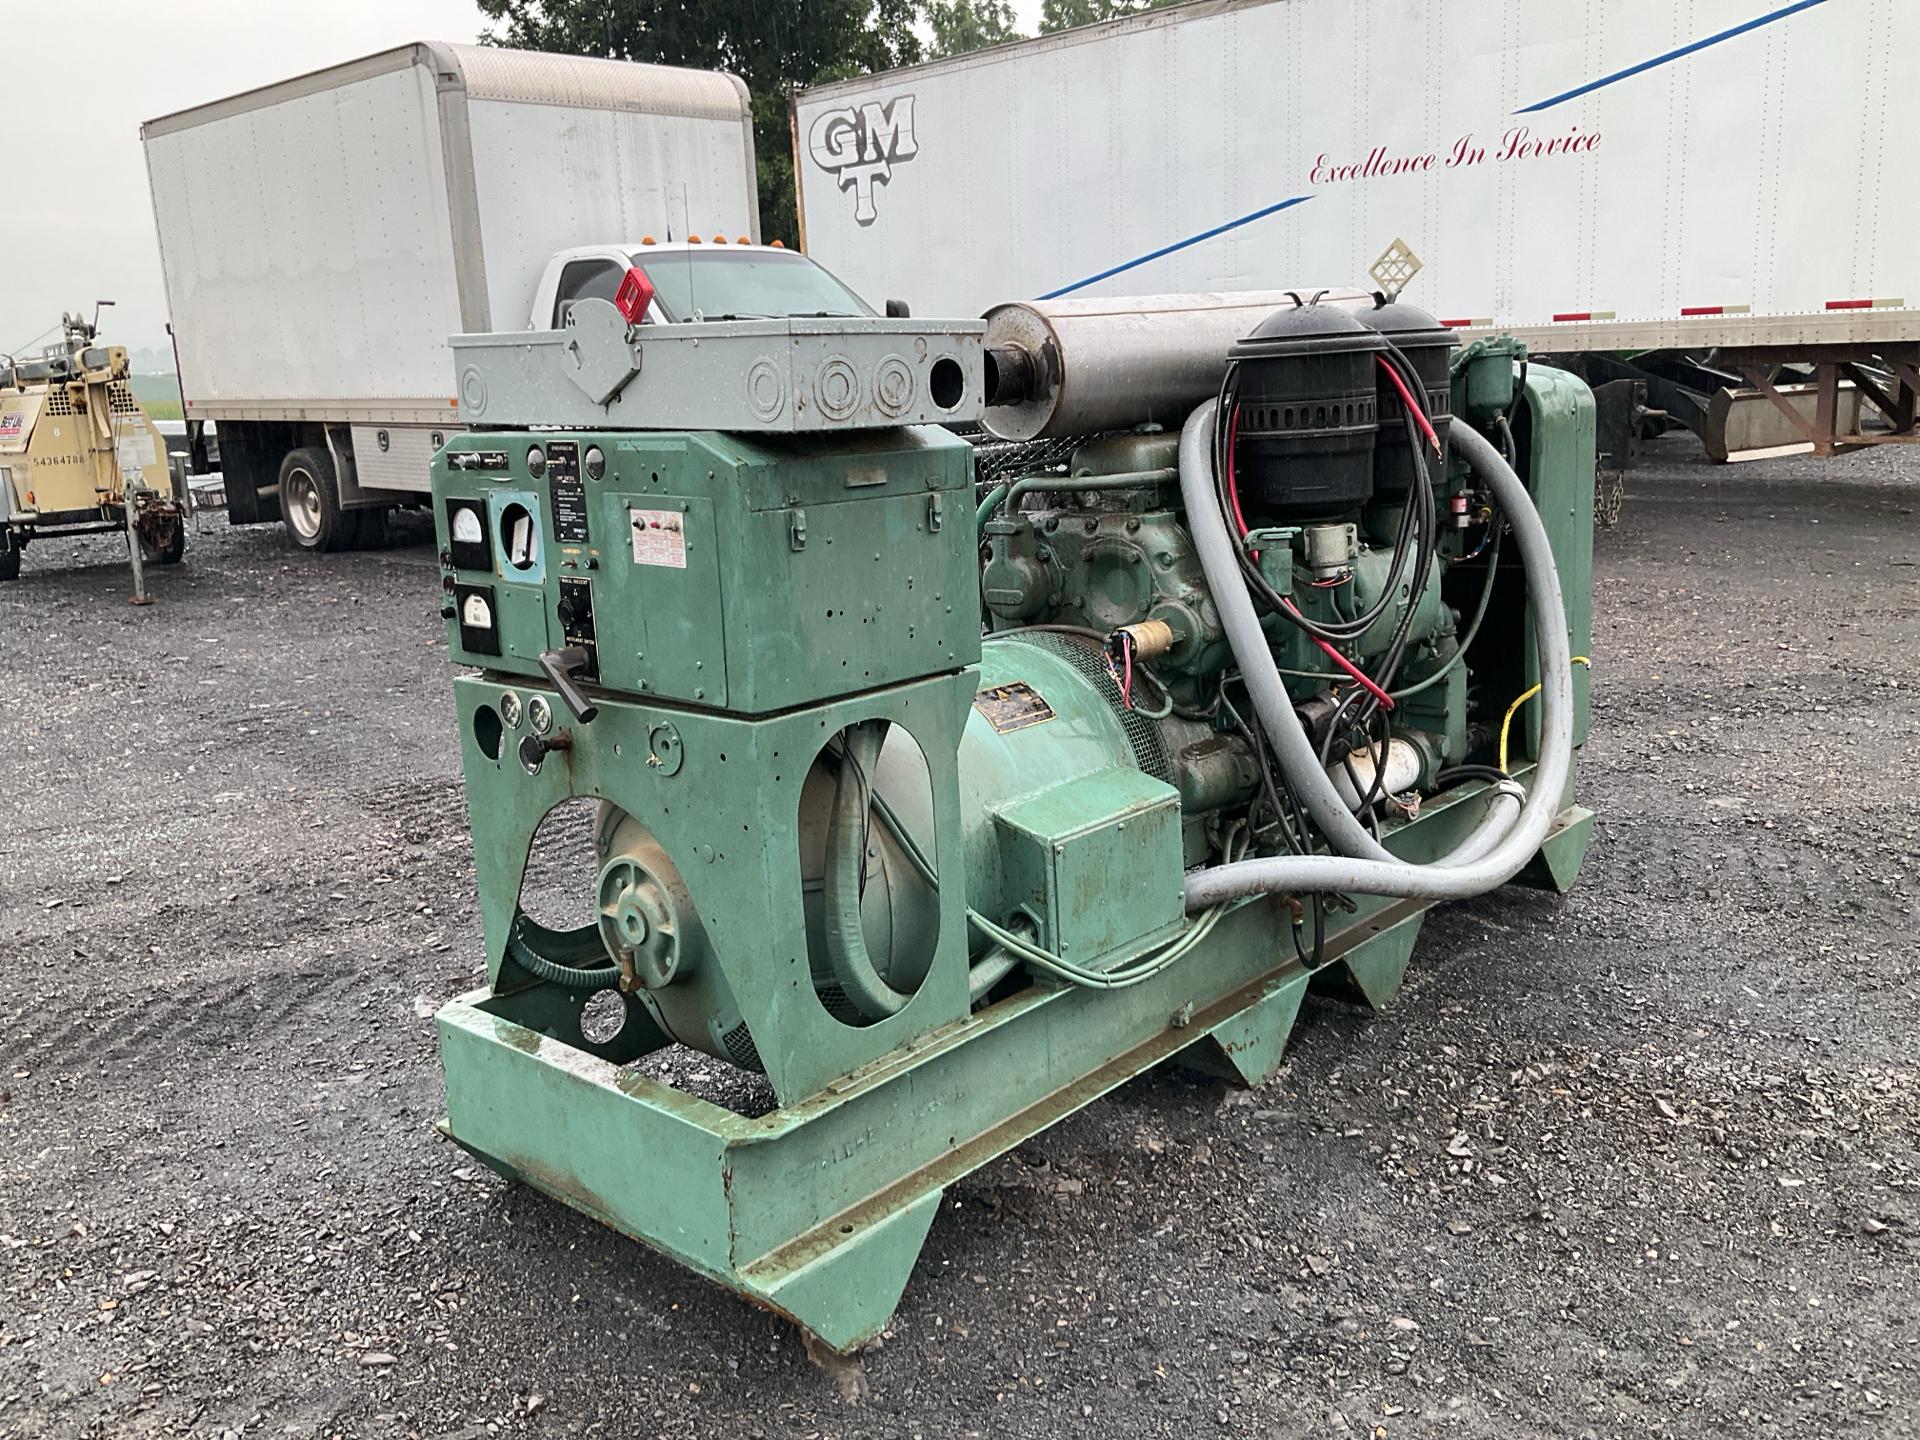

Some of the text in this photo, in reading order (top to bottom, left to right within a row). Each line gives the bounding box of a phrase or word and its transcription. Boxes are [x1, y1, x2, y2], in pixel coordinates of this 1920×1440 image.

[1309, 126, 1602, 185] Excellence In Service
